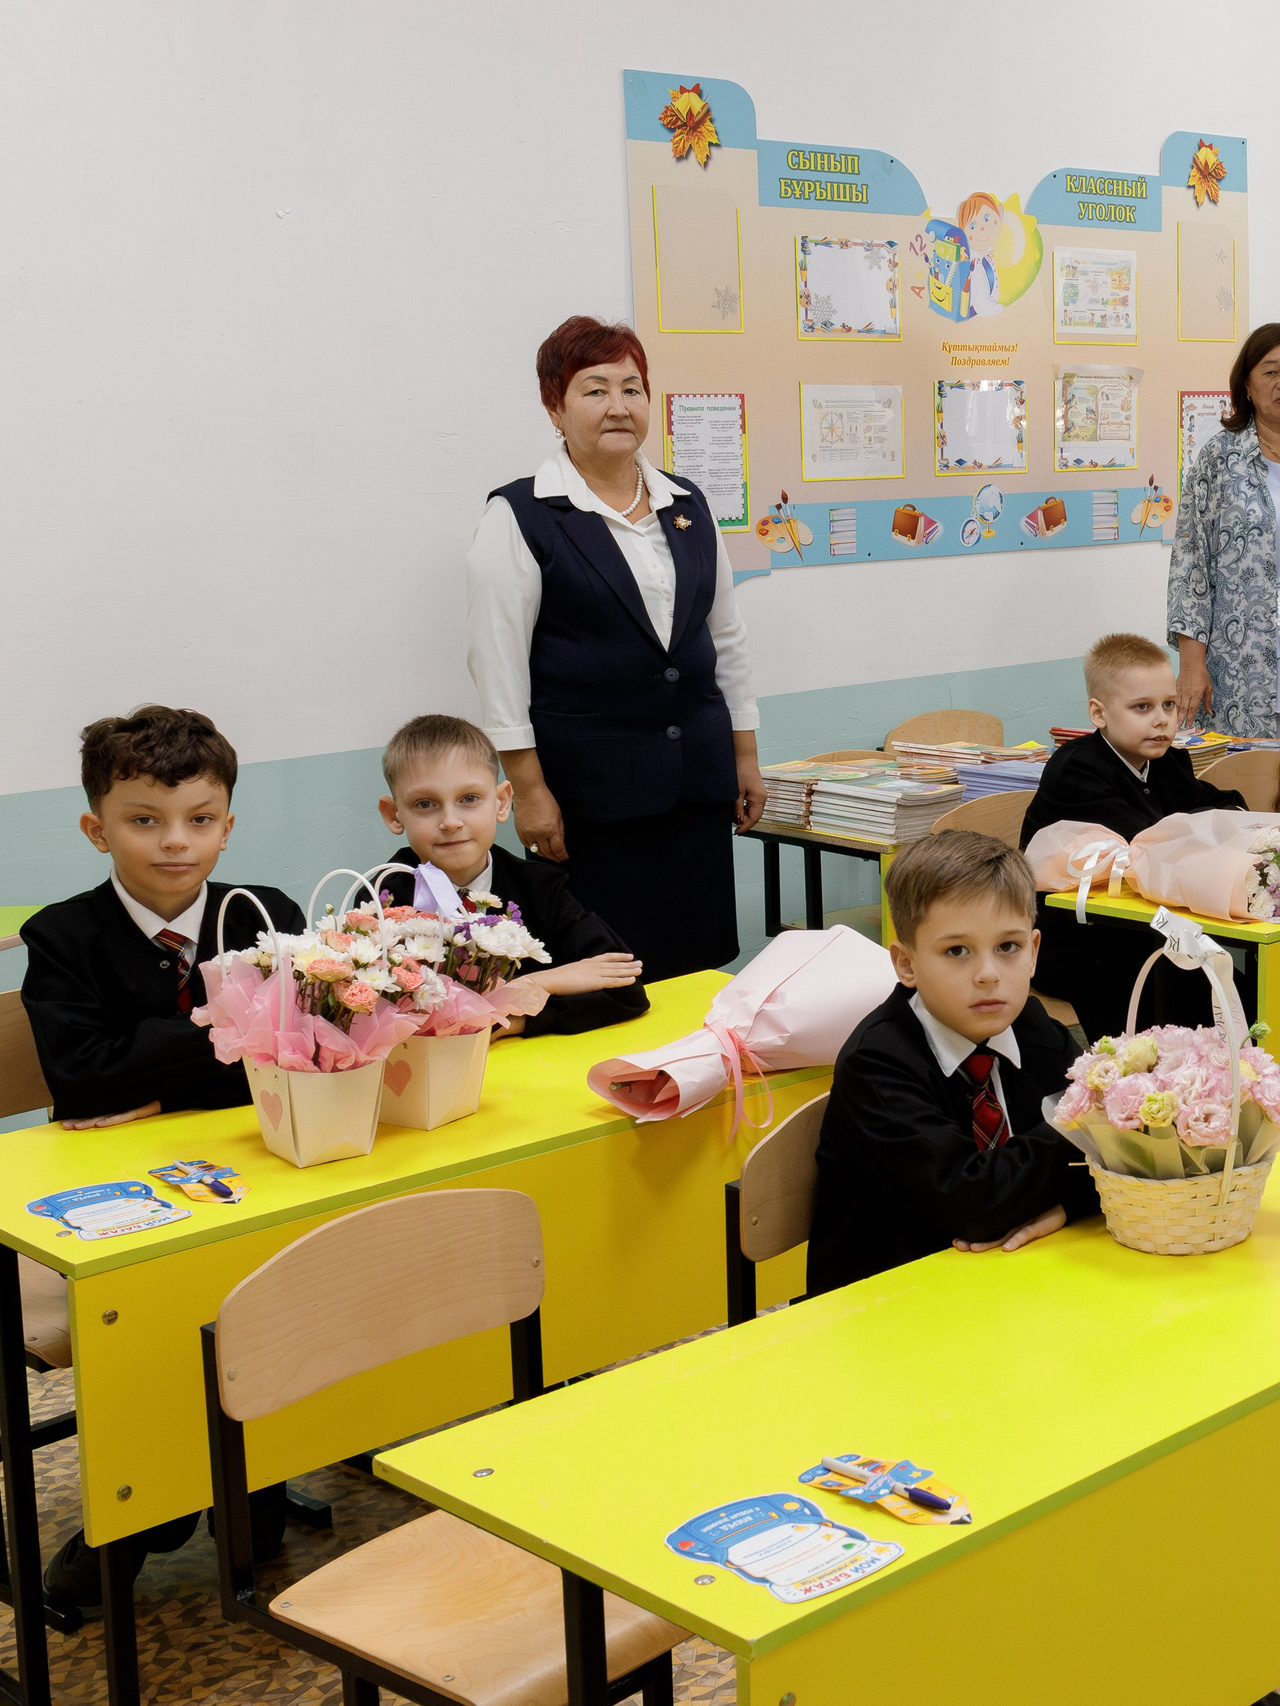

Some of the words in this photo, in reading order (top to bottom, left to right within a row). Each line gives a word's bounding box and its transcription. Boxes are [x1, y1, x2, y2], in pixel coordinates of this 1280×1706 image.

[787, 149, 860, 174] СЫНЫП
[779, 177, 869, 204] БҰРЫШЫ
[1066, 174, 1147, 199] КЛАССНЫЙ
[1077, 201, 1136, 223] УГОЛОК
[950, 356, 1011, 368] Поздравляем!
[679, 404, 704, 413] Правила
[98, 1224, 142, 1236] БАГАЖ
[143, 1216, 171, 1227] МОЙ
[849, 1556, 882, 1574] МОЙ
[799, 1572, 852, 1595] БАГАЖ
